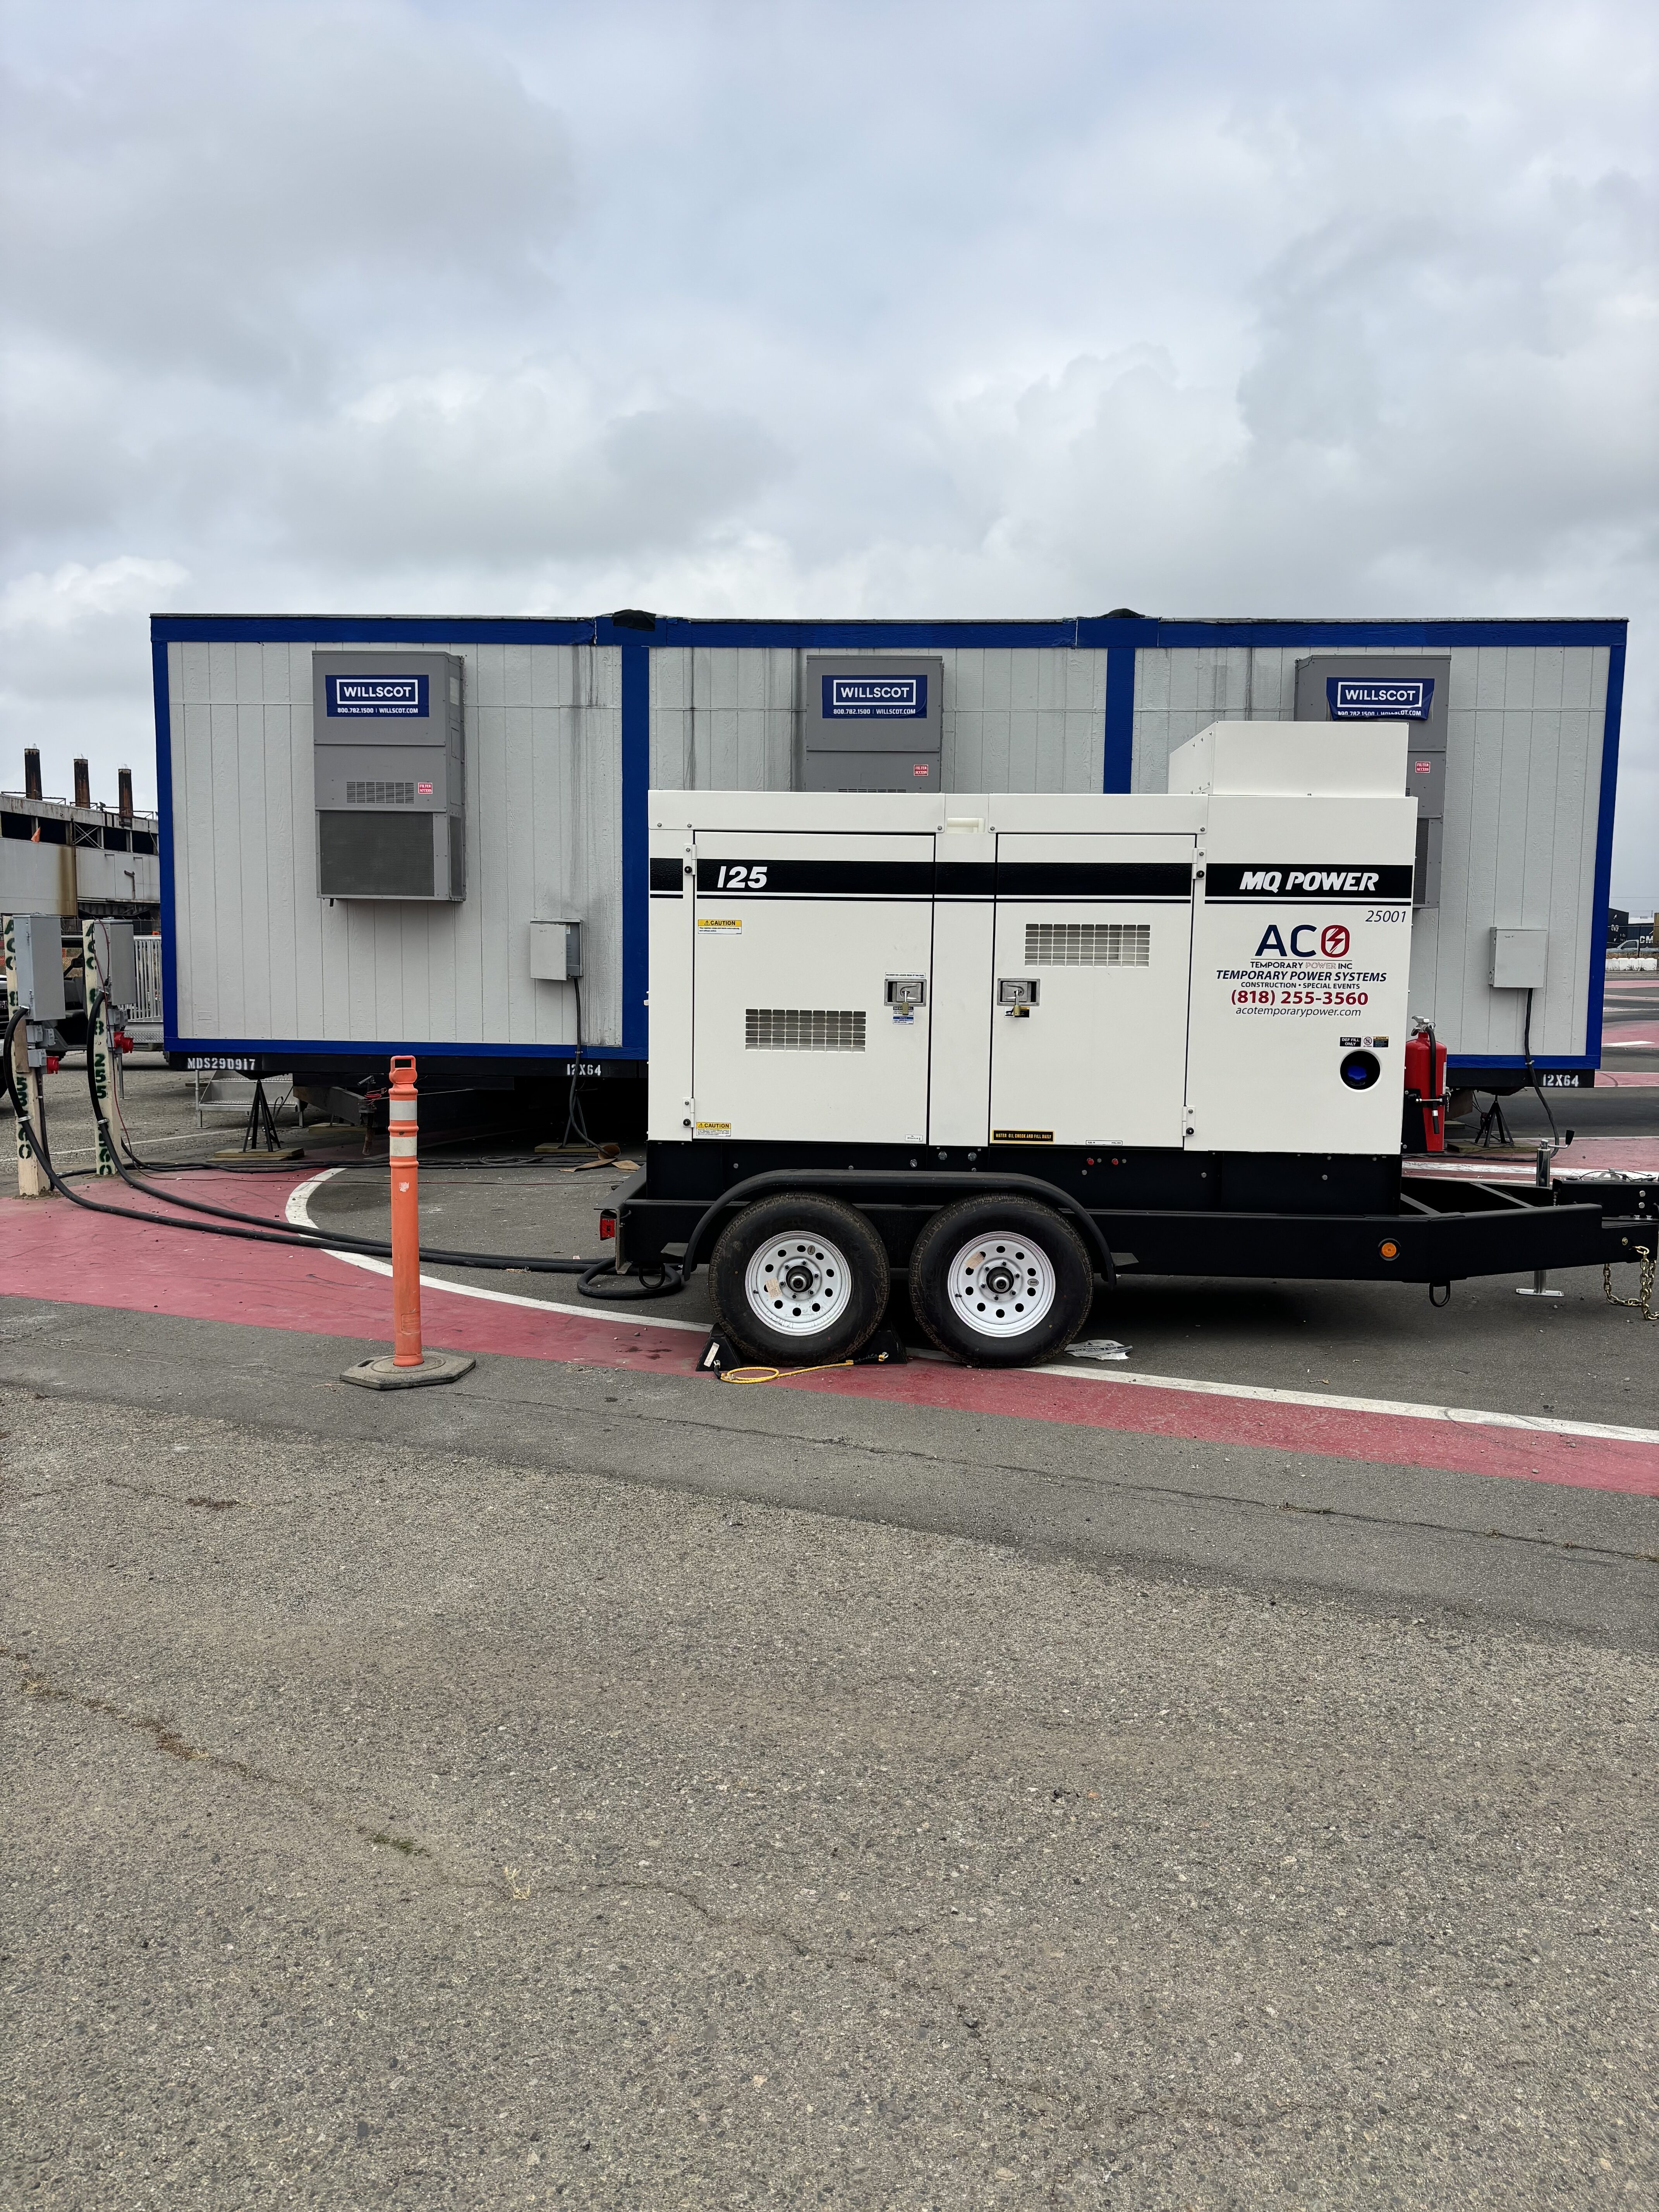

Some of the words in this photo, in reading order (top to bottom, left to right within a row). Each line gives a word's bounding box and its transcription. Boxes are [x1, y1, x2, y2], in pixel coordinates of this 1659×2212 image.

[343, 687, 412, 697] WILLSCOT
[840, 687, 910, 697] WILLSCOT
[1345, 690, 1416, 701] WILLSCOT
[717, 866, 768, 888] 125
[1239, 871, 1282, 893] MQ
[1285, 872, 1379, 891] POWER
[1365, 910, 1406, 923] 25001
[1254, 924, 1350, 958] ACO
[1216, 970, 1288, 981] TEMPORARY
[1290, 971, 1332, 981] POWER
[1334, 972, 1387, 982] SYSTEMS
[1231, 989, 1276, 1006] (818)
[1281, 991, 1369, 1005] 255-3560
[1235, 1006, 1361, 1017] acotemporarypower.com
[567, 1064, 601, 1076] 12X64
[1543, 1074, 1579, 1087] 12X64
